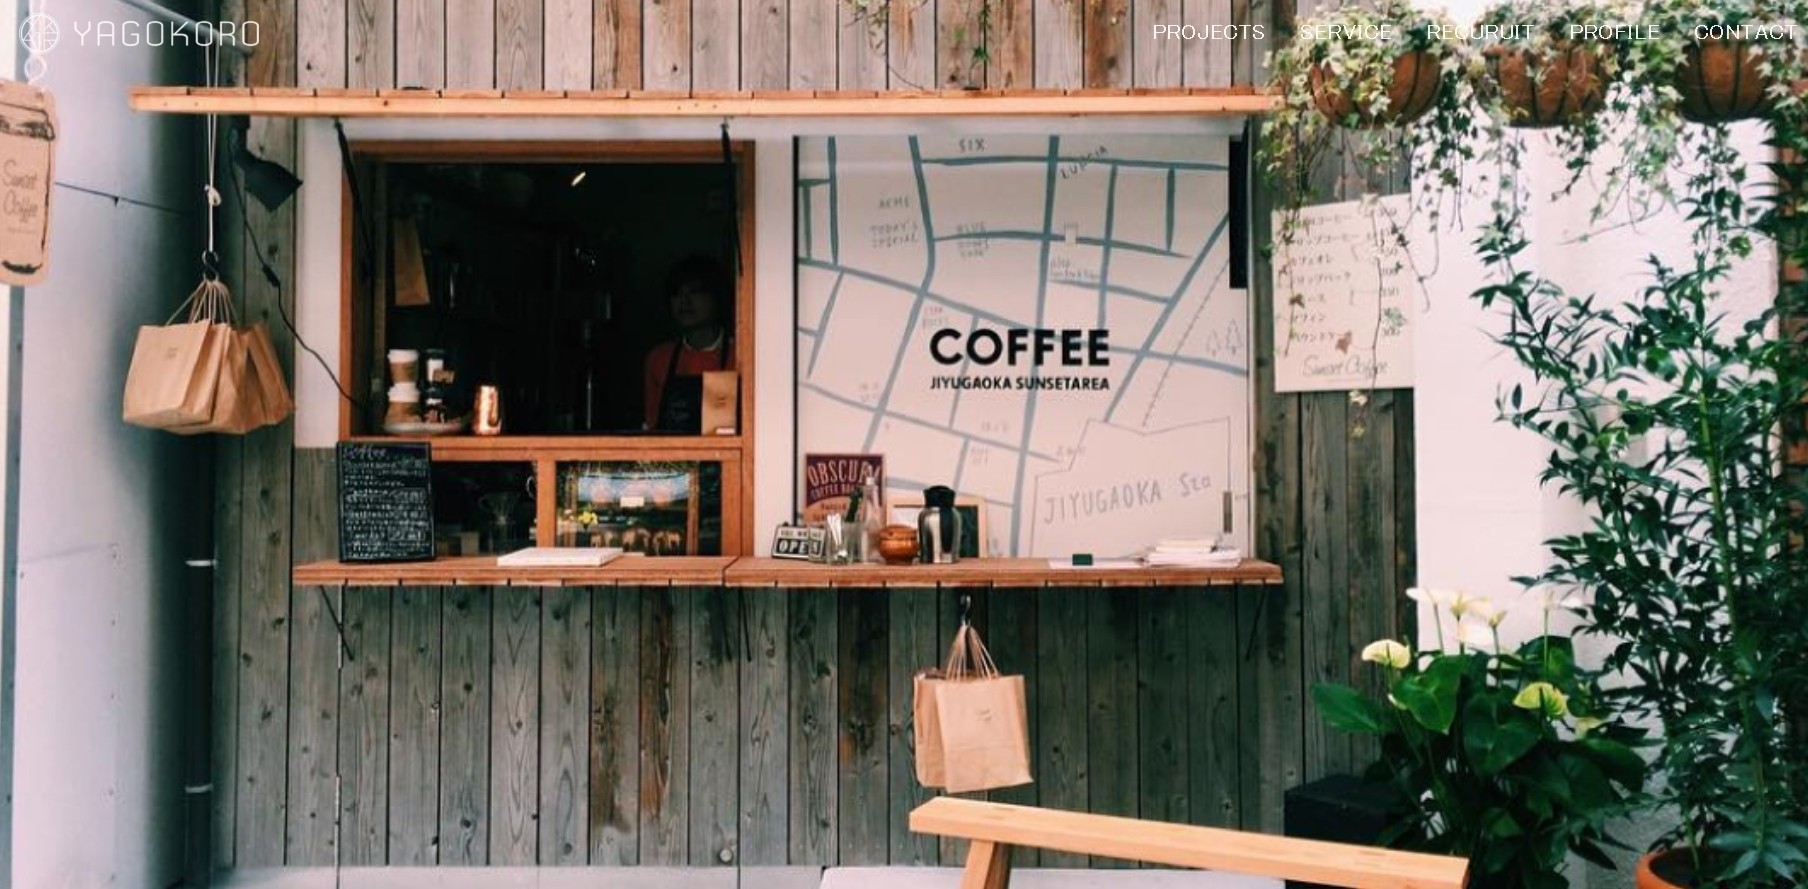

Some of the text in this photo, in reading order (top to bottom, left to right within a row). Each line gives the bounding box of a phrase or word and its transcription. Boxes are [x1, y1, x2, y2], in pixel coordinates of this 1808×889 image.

[959, 138, 985, 153] SIX
[929, 327, 1111, 366] COFFEE
[930, 376, 1110, 391] JIYUGAOKA SUNSETAREA
[1043, 480, 1162, 525] JIYUGAOKA
